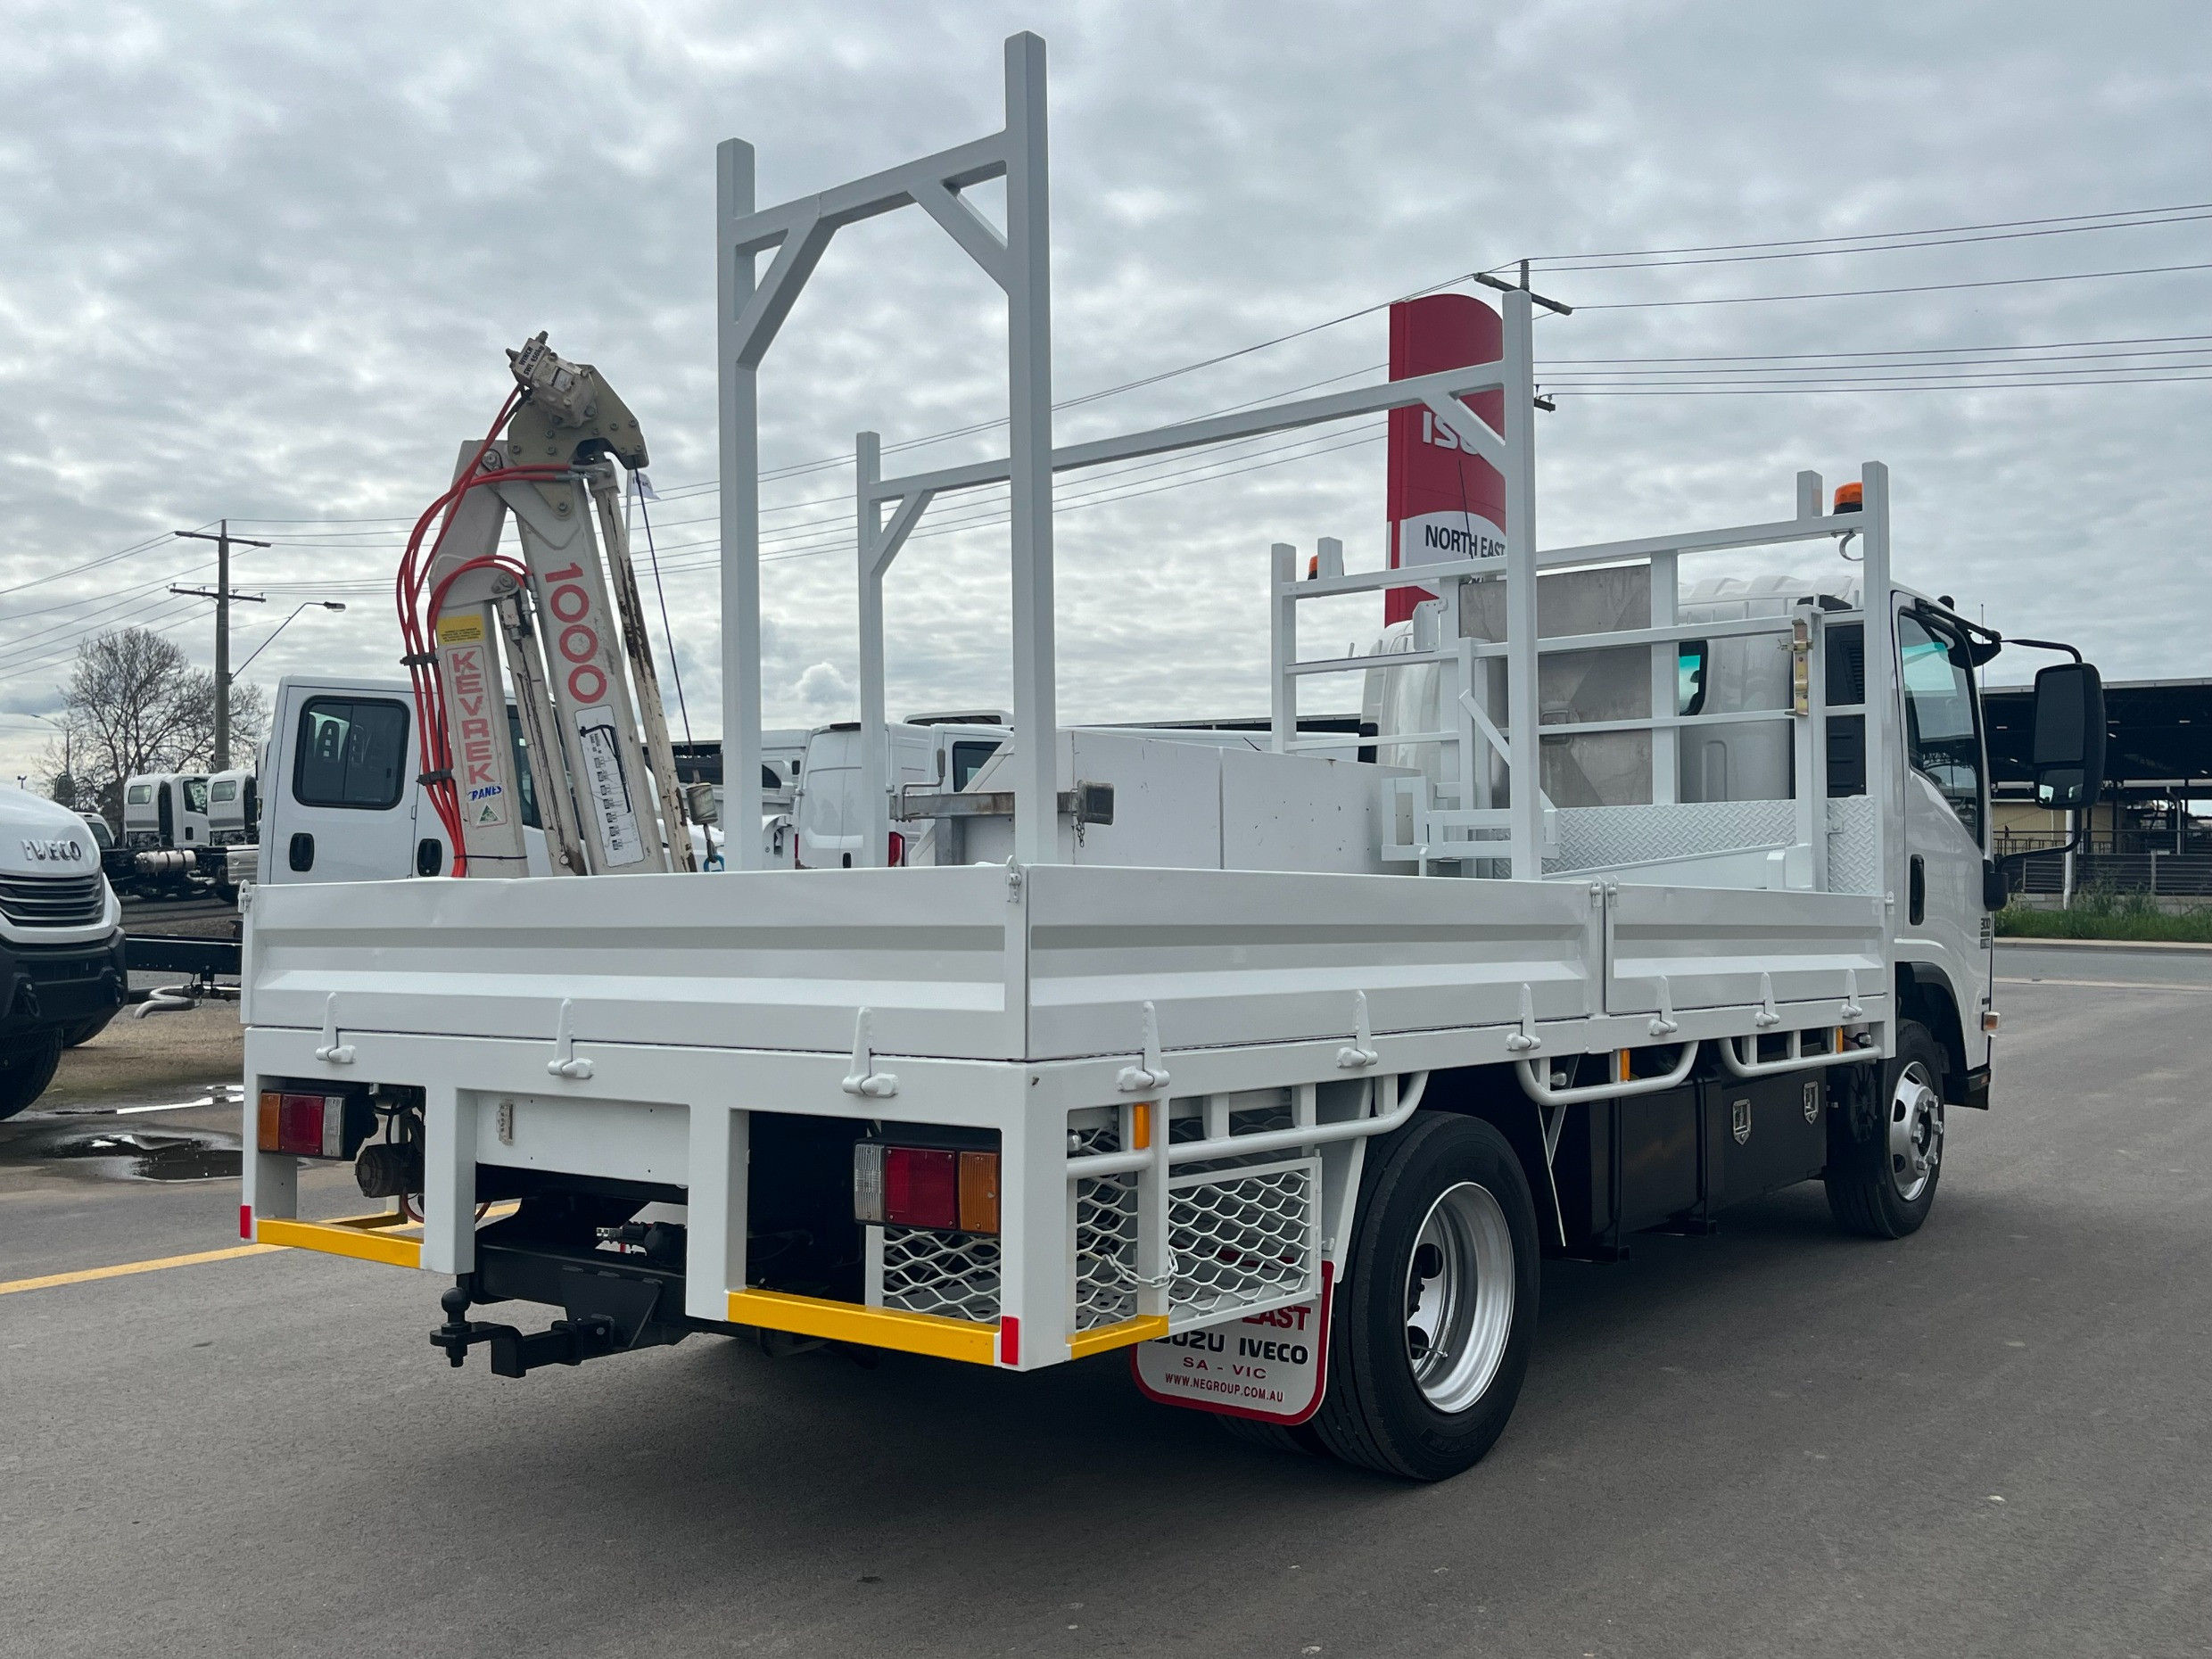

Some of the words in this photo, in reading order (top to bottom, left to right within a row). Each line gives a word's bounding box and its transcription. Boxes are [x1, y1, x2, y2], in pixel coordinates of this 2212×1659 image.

[519, 346, 533, 366] WINCH
[1425, 524, 1477, 557] NORTH
[1481, 537, 1506, 557] EAST
[545, 562, 607, 704] 1000
[452, 651, 495, 785] KEVREK
[21, 839, 82, 861] IVECO
[1240, 1338, 1308, 1365] IVECO
[1183, 1357, 1209, 1371] SA
[1233, 1365, 1267, 1379] VIC
[1165, 1374, 1283, 1402] WWW.NEGROUP.COM.AU
